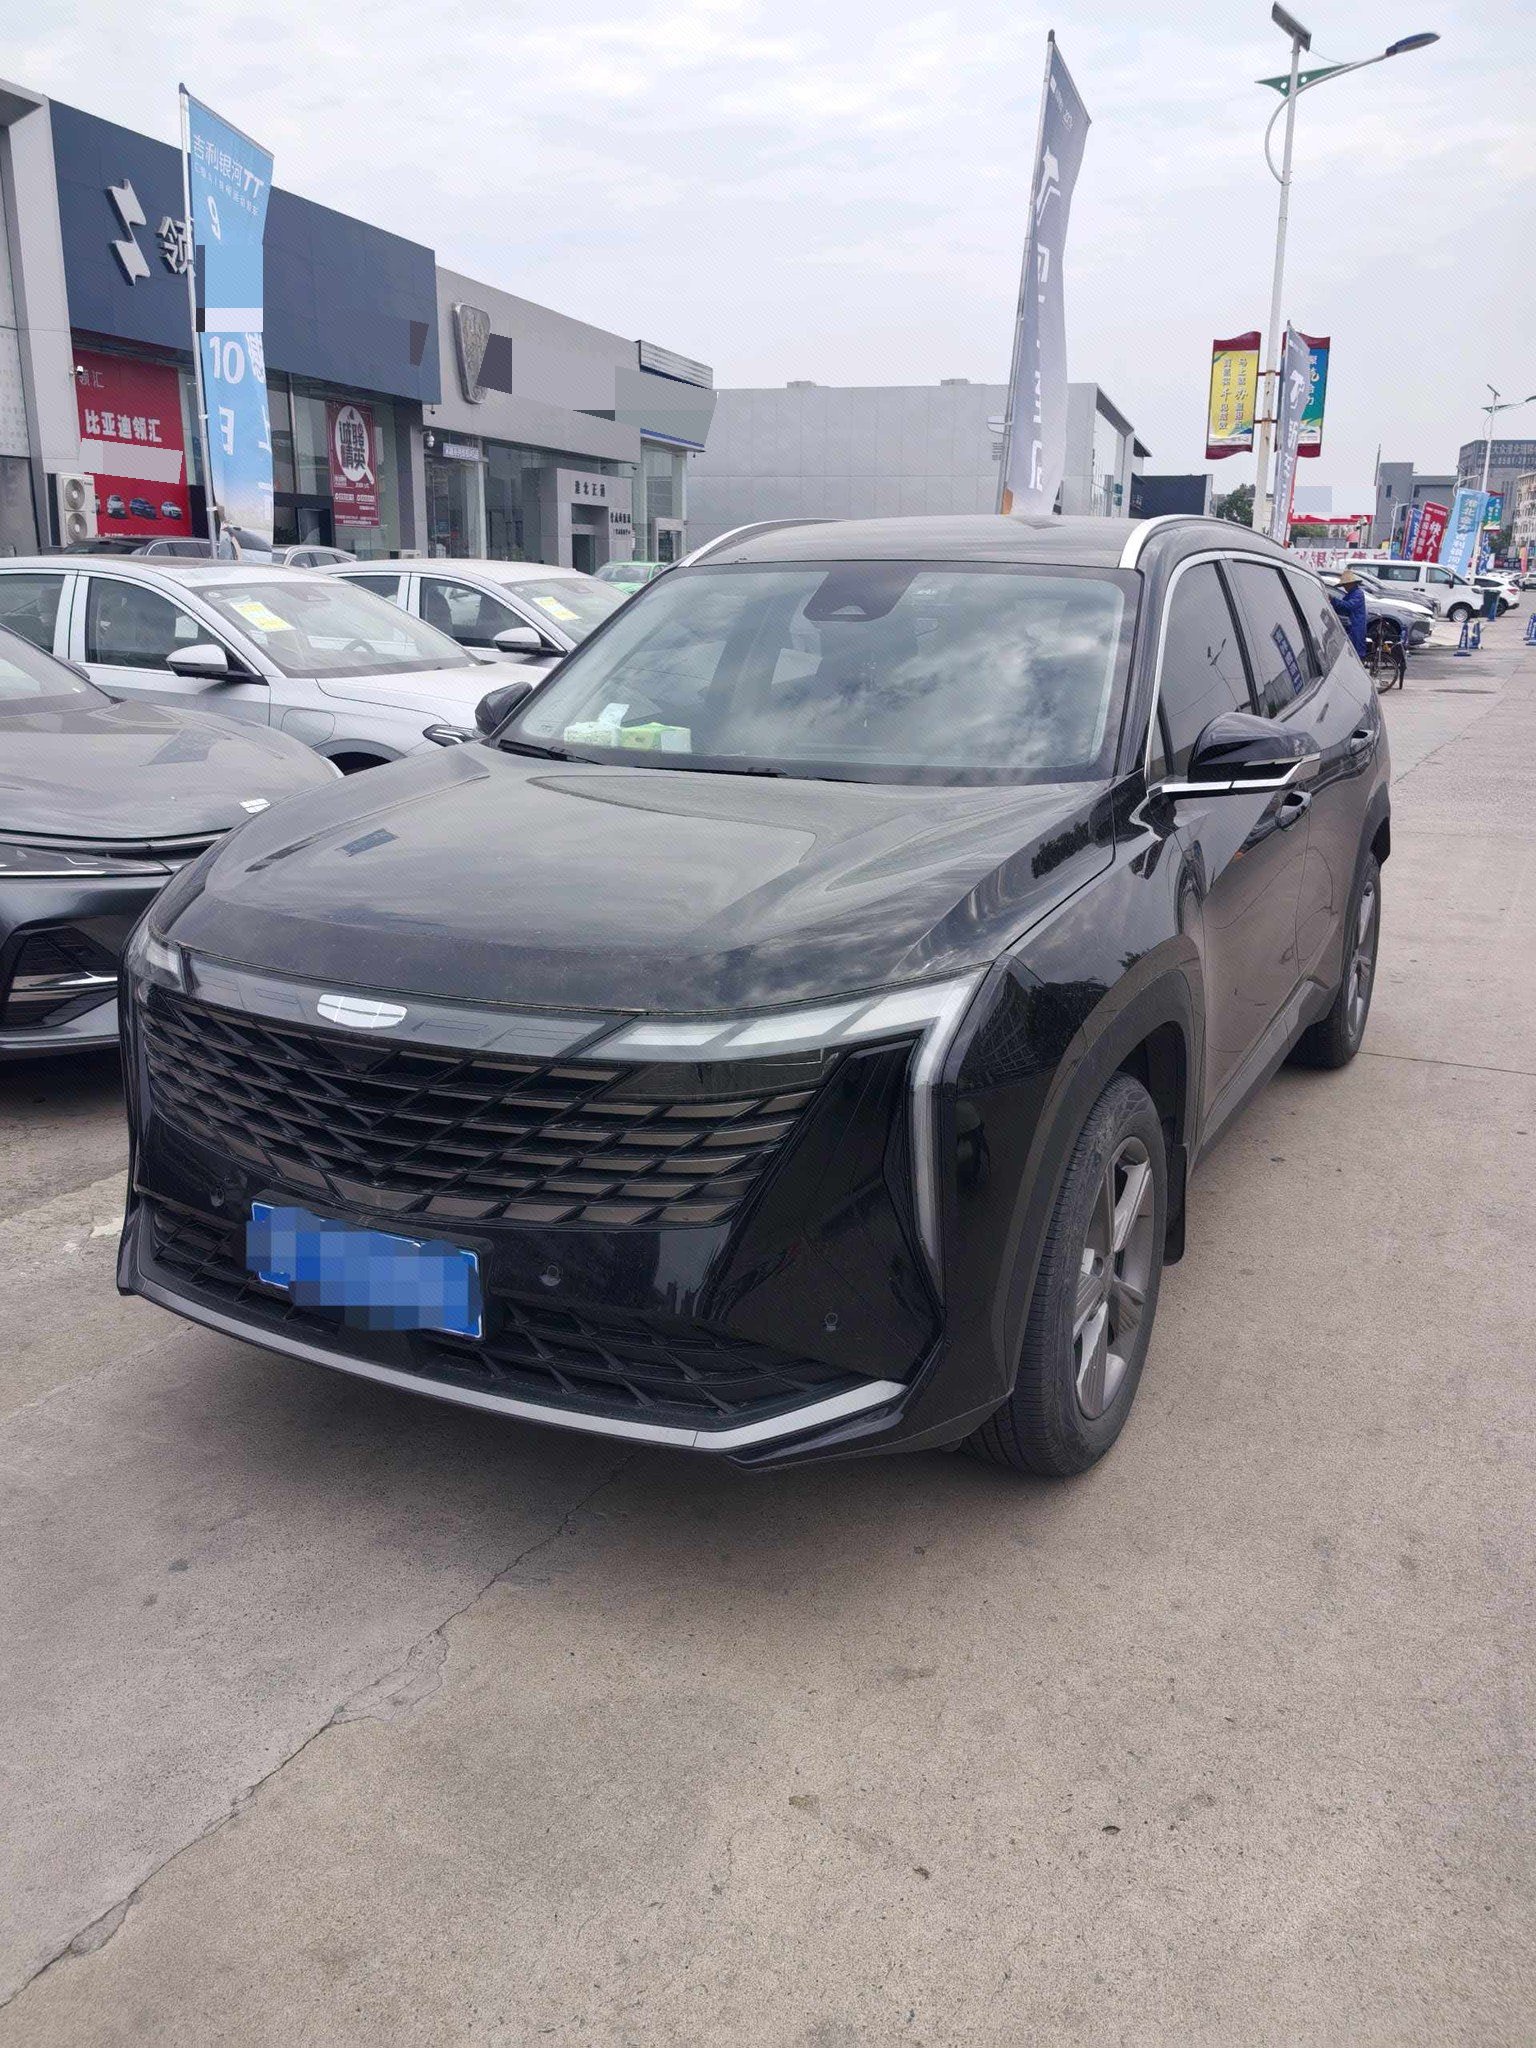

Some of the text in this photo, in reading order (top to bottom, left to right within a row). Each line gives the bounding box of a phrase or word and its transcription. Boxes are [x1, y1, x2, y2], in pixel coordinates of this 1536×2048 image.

[84, 409, 163, 443] 比亚迪领汇
